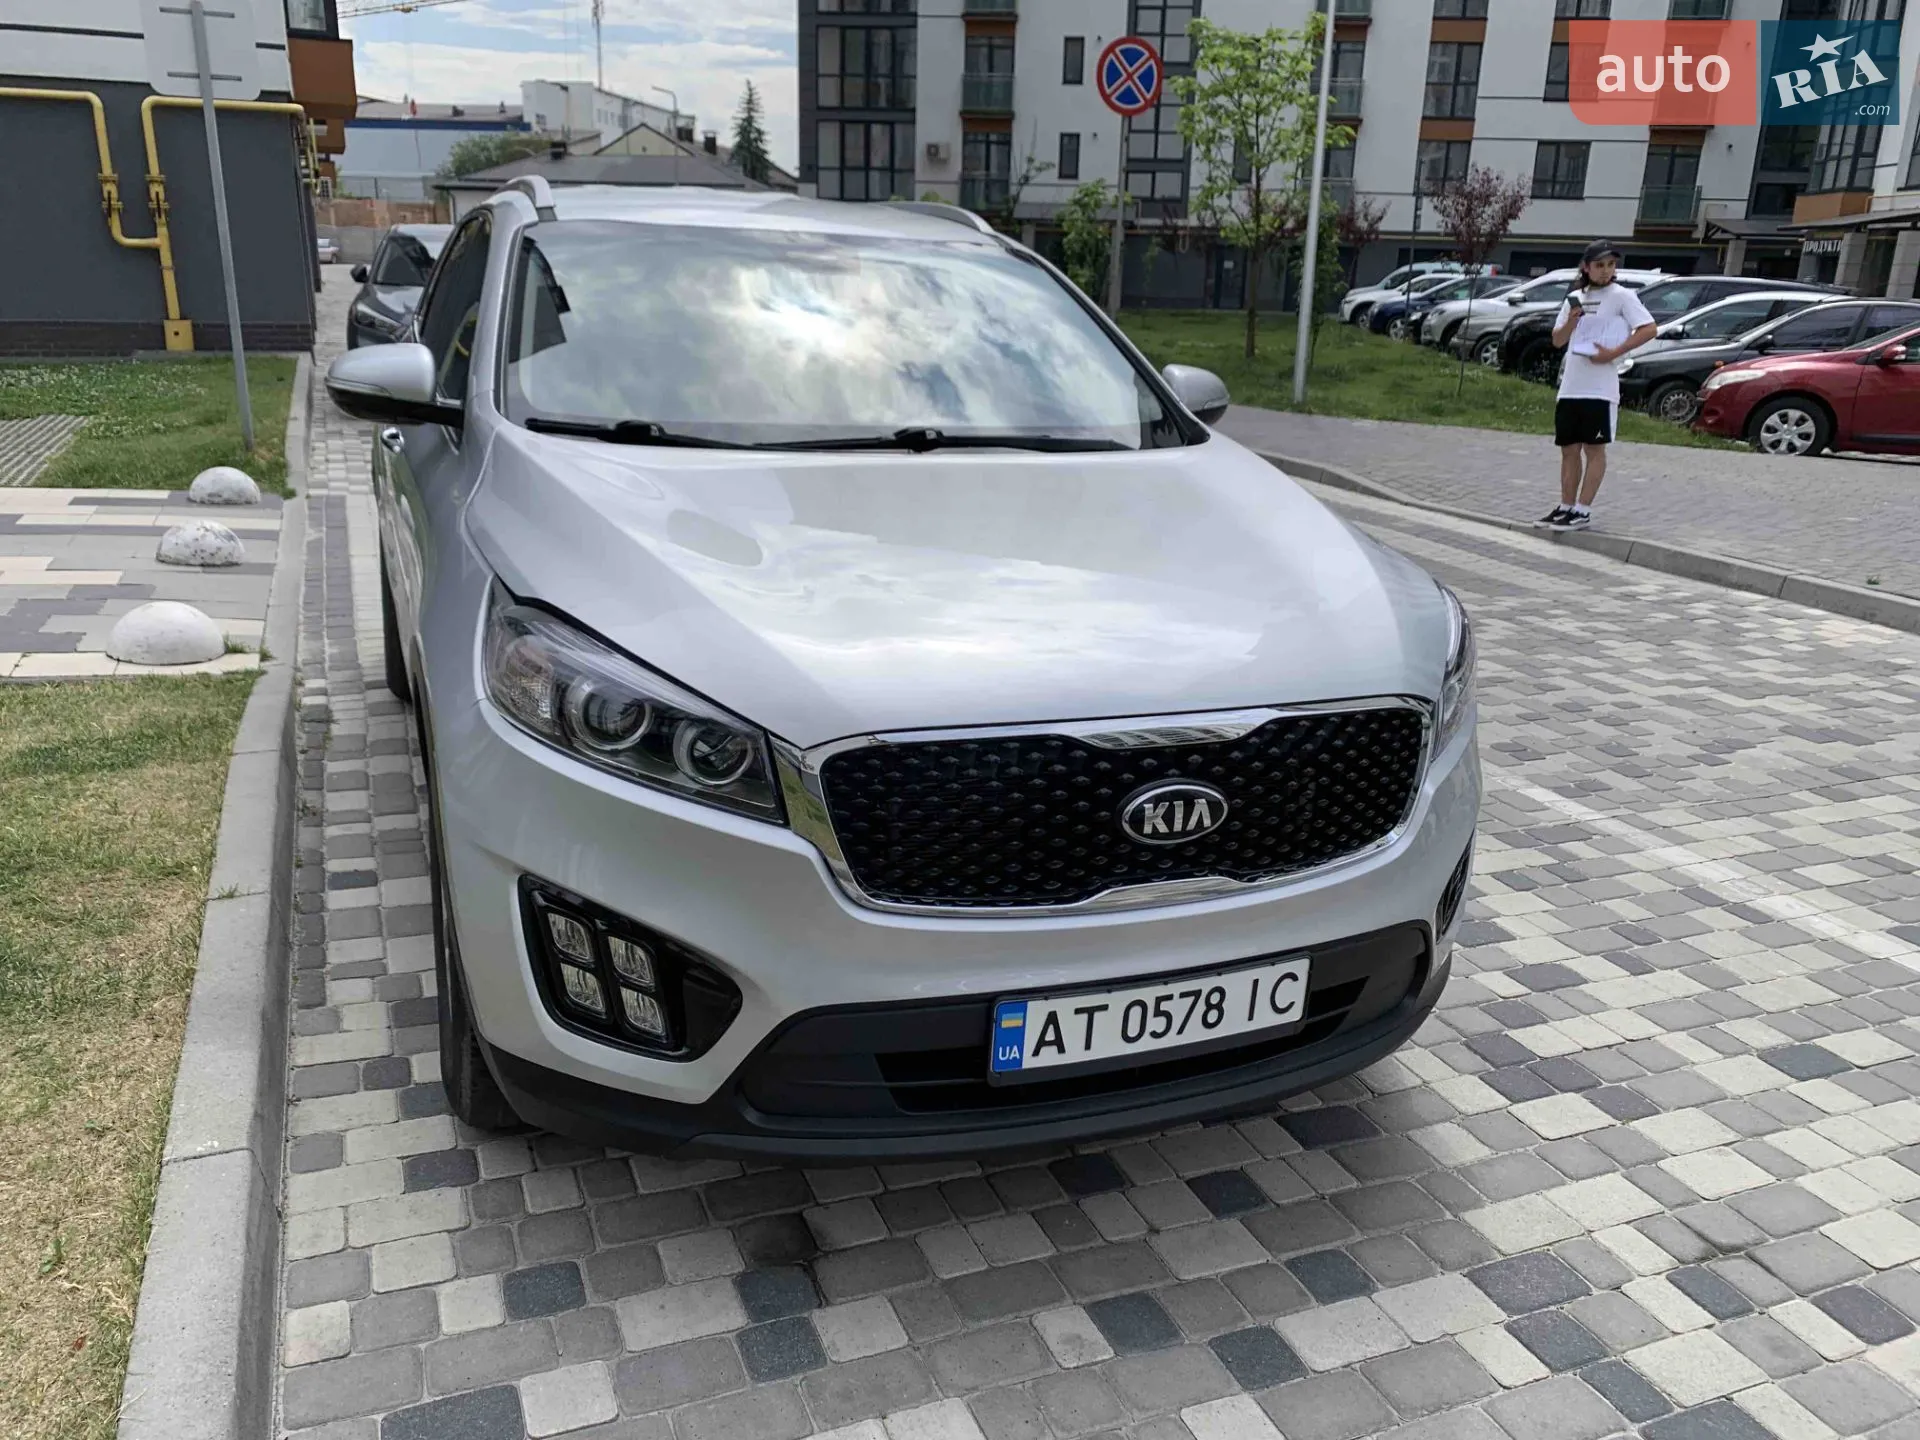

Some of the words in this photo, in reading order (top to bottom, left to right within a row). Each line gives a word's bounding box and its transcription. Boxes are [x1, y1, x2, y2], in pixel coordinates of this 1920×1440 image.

[1142, 798, 1212, 835] KIA
[1031, 1004, 1109, 1058] AT
[1120, 985, 1227, 1045] 0578
[1247, 971, 1299, 1023] IC
[998, 1044, 1020, 1061] UA
